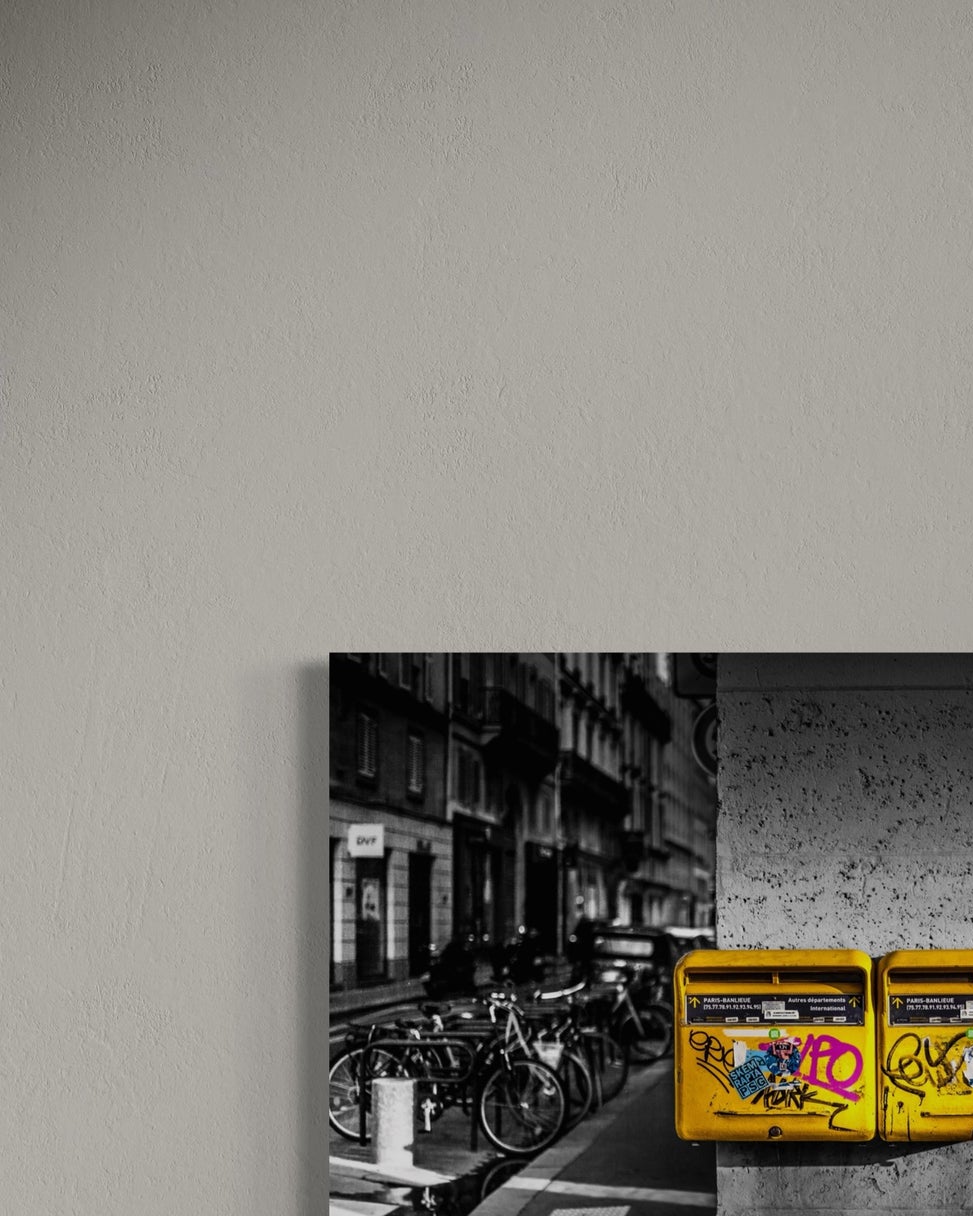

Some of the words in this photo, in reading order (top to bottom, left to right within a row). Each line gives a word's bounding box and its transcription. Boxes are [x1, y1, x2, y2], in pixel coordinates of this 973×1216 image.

[730, 1060, 758, 1080] SKEM
[735, 1070, 763, 1090] RAPTA
[740, 1078, 768, 1097] PSG
